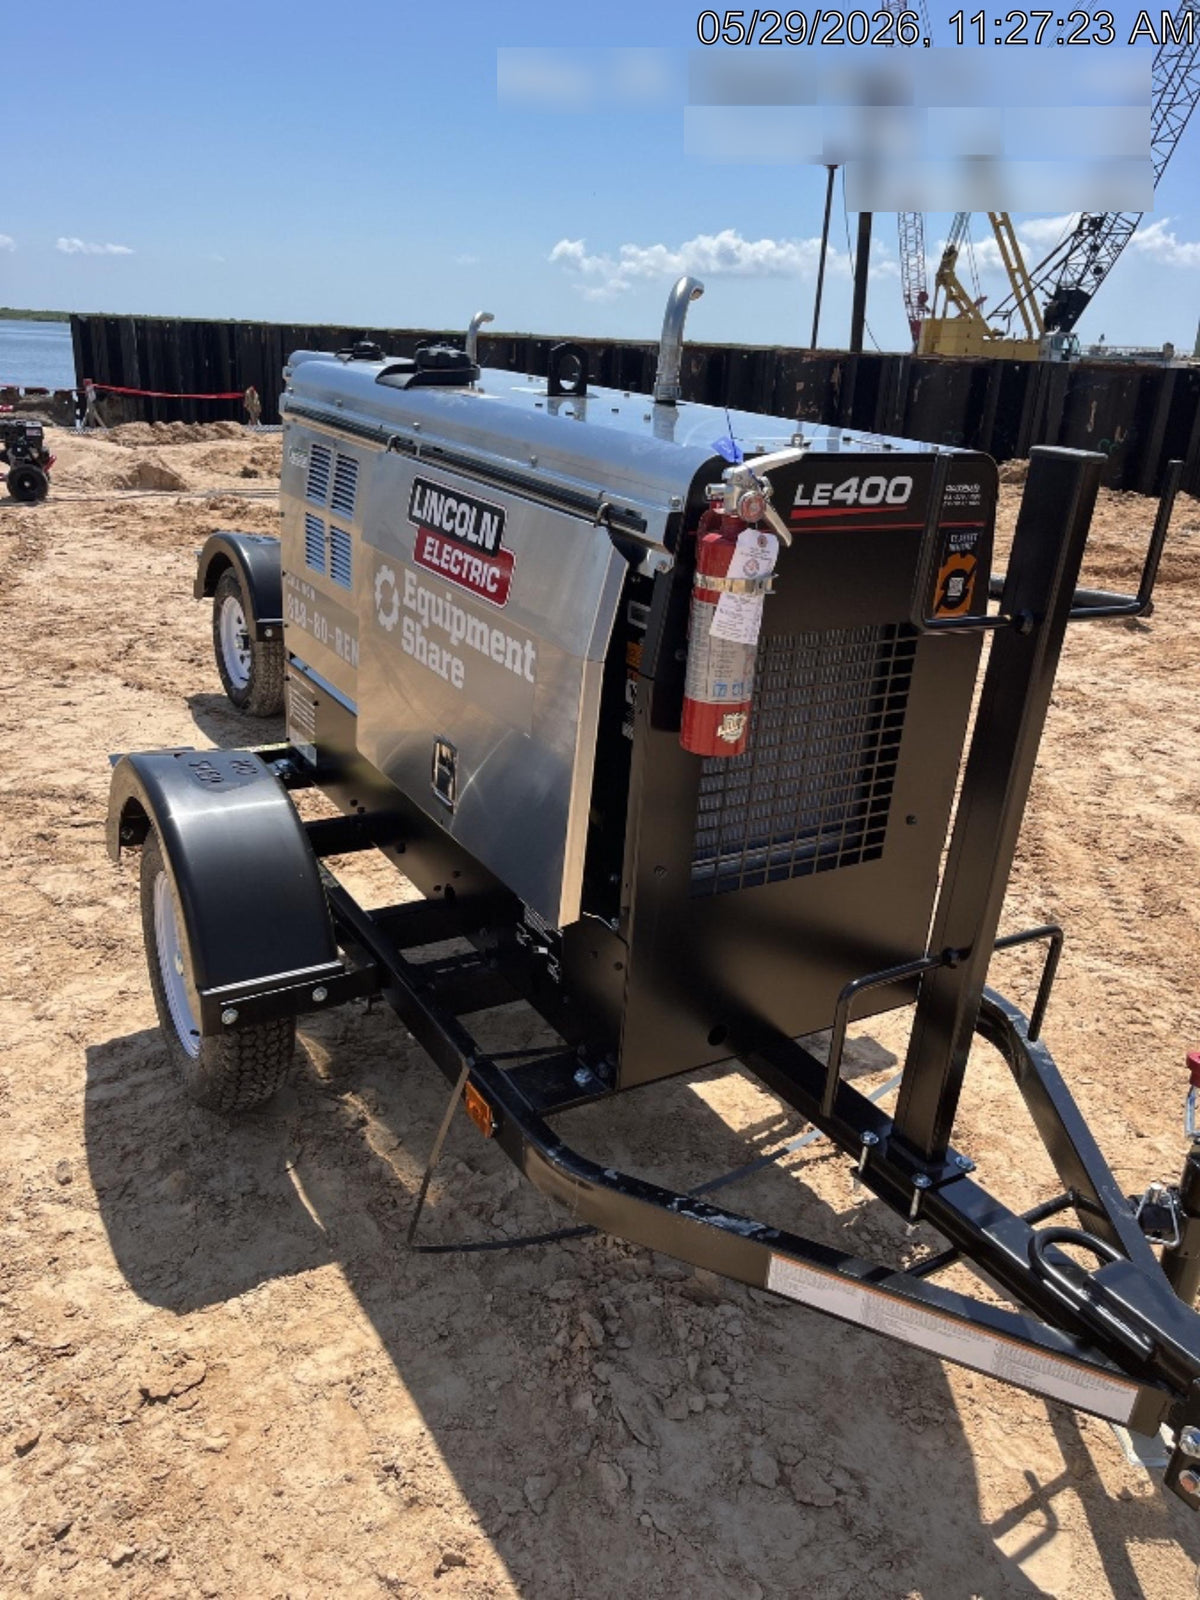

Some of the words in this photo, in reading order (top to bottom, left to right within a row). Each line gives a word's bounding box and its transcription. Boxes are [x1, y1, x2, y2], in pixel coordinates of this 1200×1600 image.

[411, 485, 500, 550] LINCOLN
[793, 476, 913, 506] LE400
[422, 536, 501, 594] ELECTRIC
[401, 616, 465, 689] Share
[402, 568, 537, 684] Equipment
